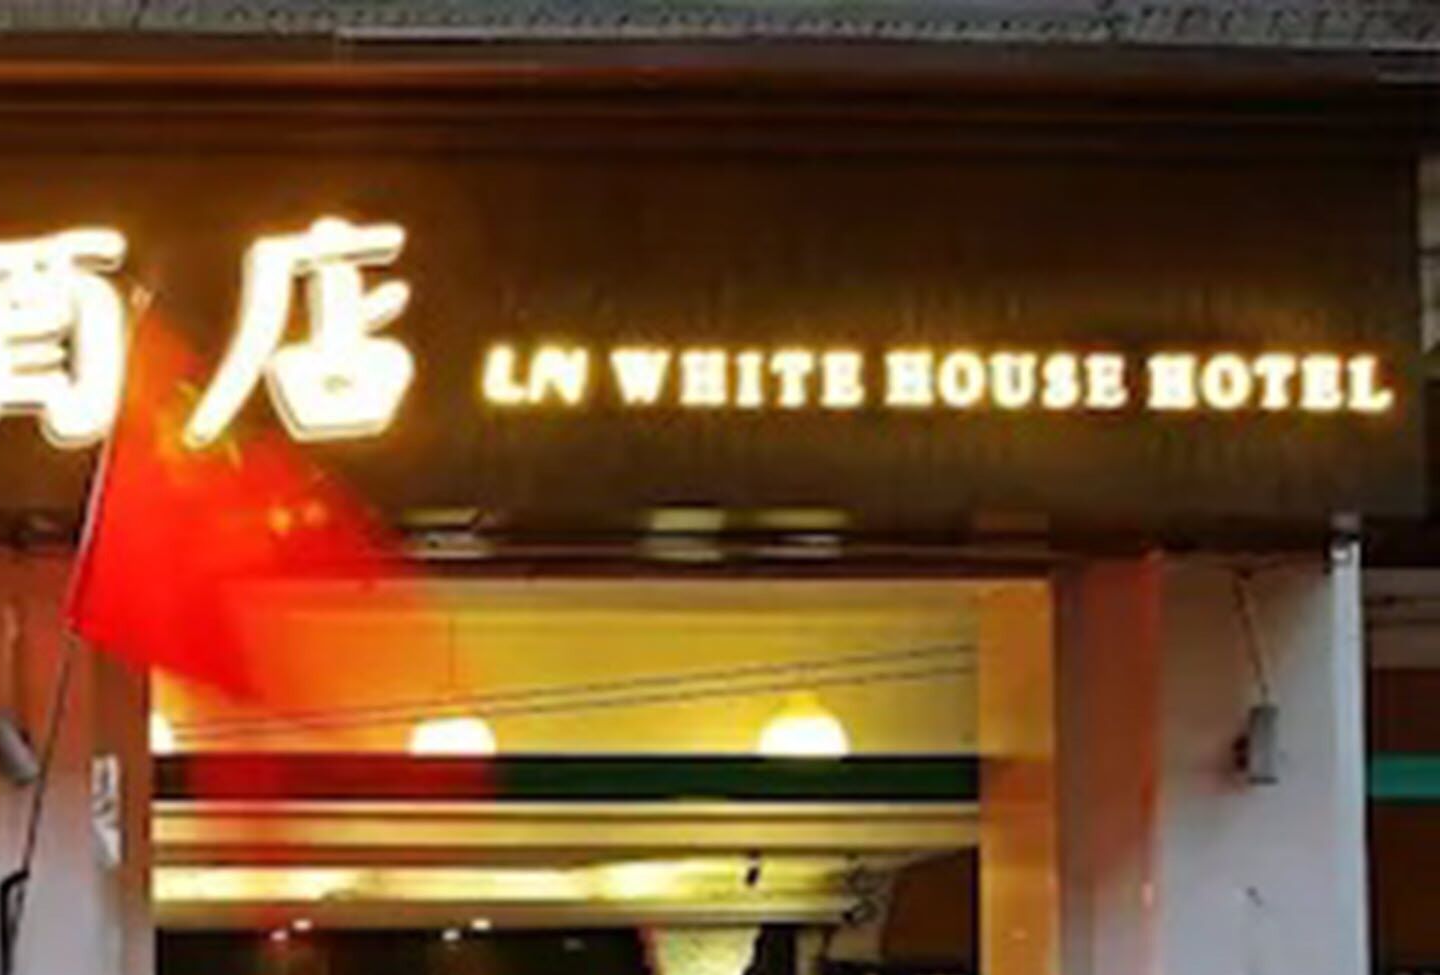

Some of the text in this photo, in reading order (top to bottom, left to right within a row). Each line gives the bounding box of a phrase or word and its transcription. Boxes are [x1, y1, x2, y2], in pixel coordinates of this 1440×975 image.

[610, 348, 864, 407] WHITE
[885, 350, 1127, 409] HOUSE
[1148, 353, 1393, 411] HOTEL
